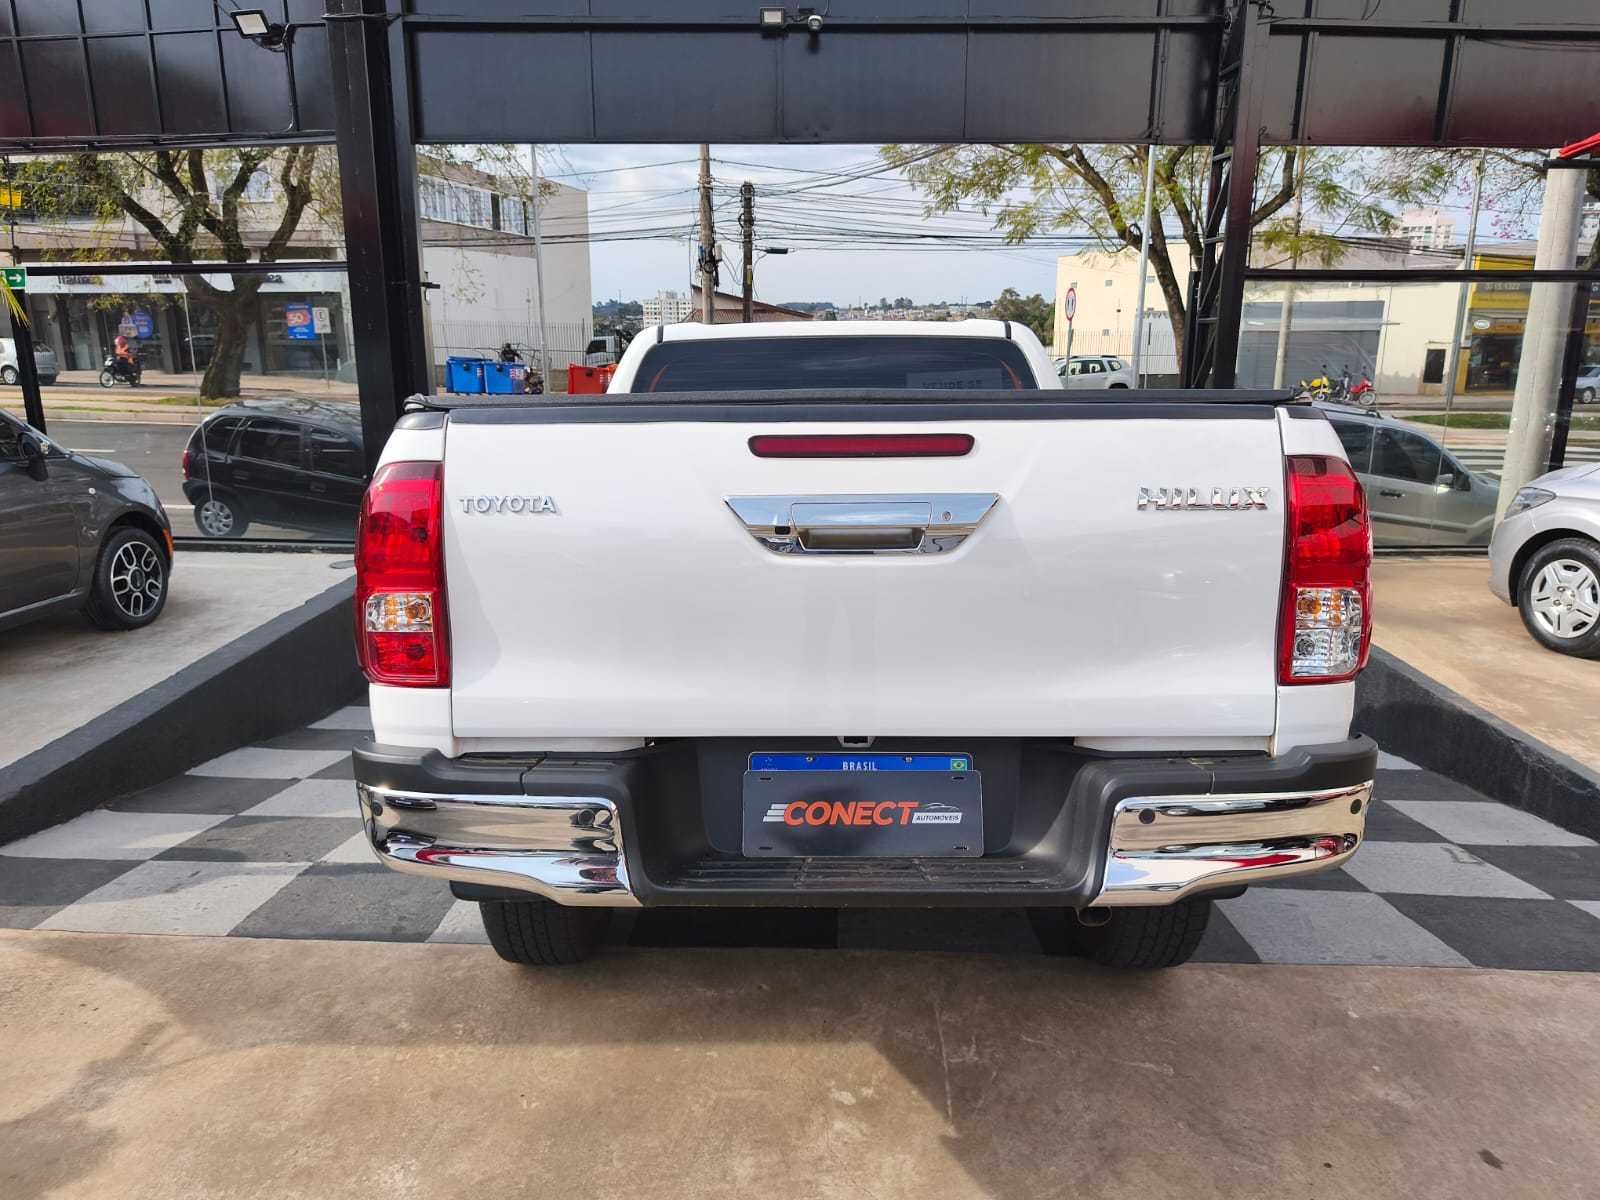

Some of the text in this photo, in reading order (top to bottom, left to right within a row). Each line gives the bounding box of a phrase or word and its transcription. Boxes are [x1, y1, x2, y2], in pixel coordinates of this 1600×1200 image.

[459, 495, 558, 514] TOYOTA
[1137, 486, 1269, 510] HILUX
[842, 760, 878, 771] BRASIL
[784, 801, 918, 826] CONECT
